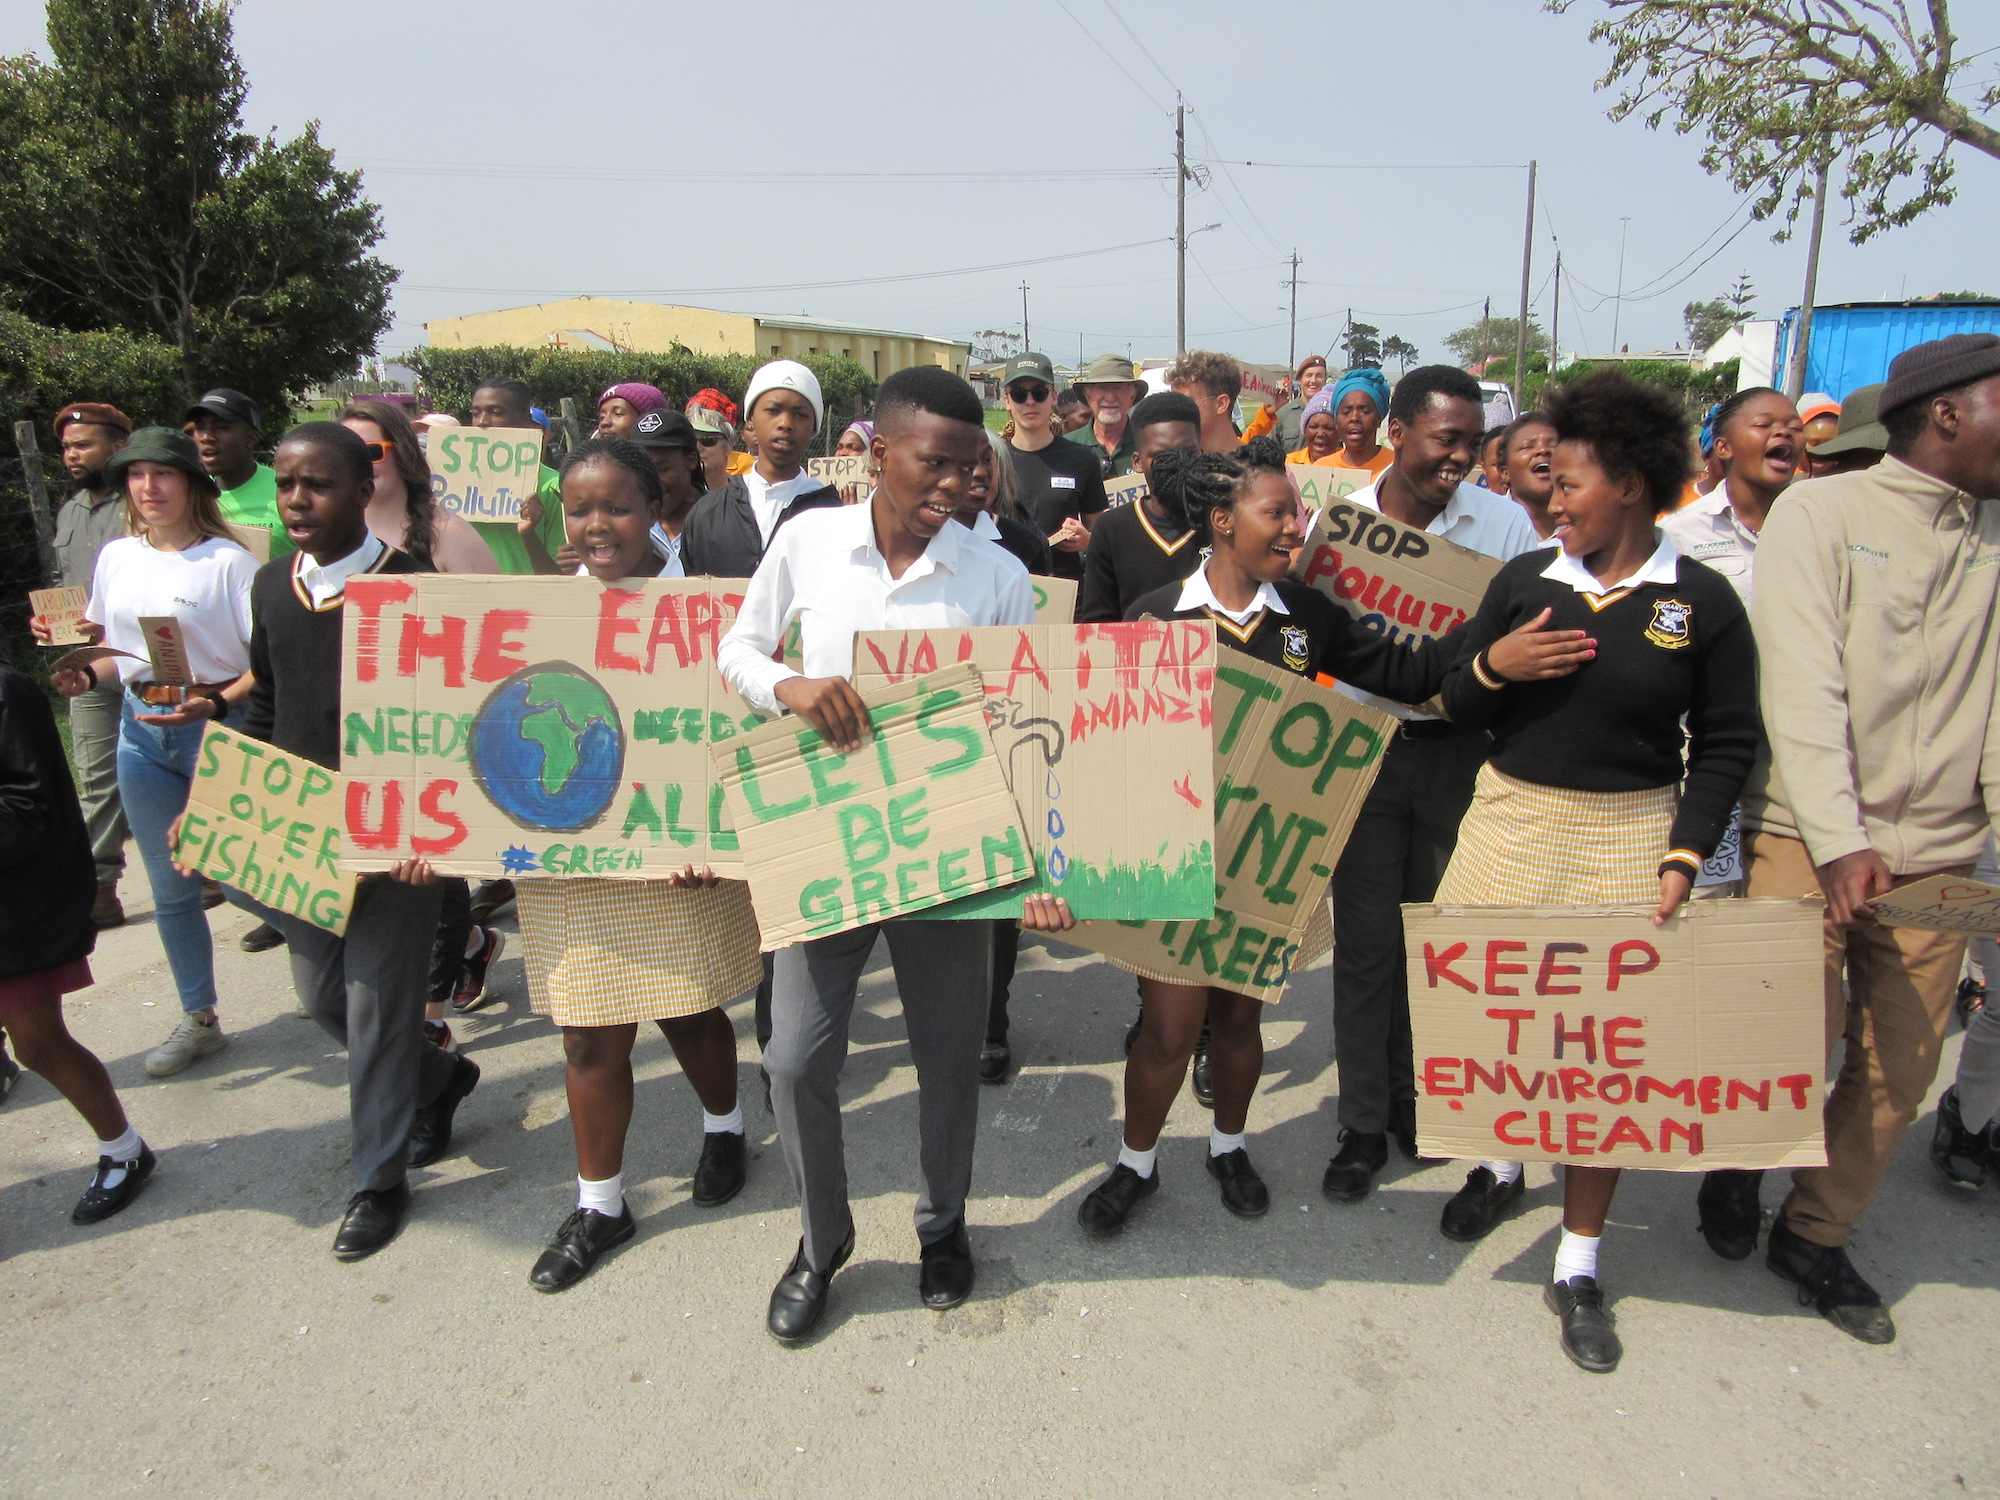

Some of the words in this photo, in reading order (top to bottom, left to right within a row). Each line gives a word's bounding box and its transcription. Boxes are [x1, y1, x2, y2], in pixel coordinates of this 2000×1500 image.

[441, 434, 540, 479] STOP
[810, 458, 857, 478] STOP
[1327, 504, 1430, 559] STOP
[36, 588, 86, 612] UBUNTU
[344, 579, 535, 689] THE
[198, 731, 334, 808] STOP
[230, 793, 341, 880] OVER
[345, 778, 470, 858] US
[621, 782, 740, 851] ALL
[835, 787, 931, 873] BE
[799, 825, 1029, 937] GREEN
[1424, 939, 1661, 996] KEEP
[1486, 1008, 1648, 1069] THE
[1421, 1057, 1813, 1114] ENVIROMENT
[1494, 1110, 1704, 1156] CLEAN
